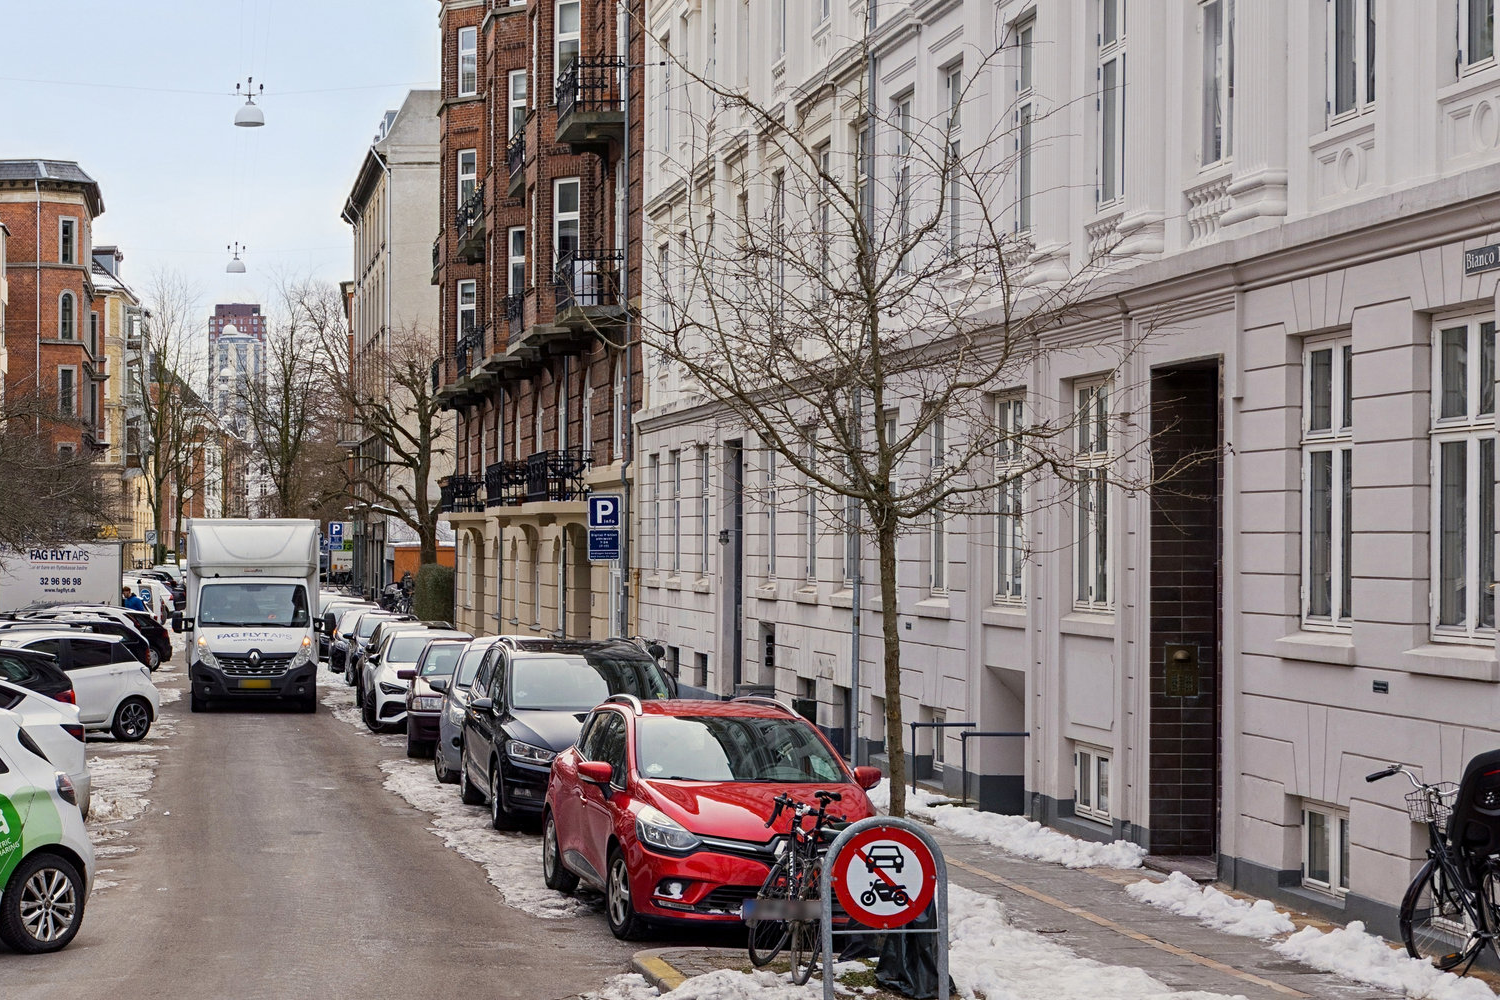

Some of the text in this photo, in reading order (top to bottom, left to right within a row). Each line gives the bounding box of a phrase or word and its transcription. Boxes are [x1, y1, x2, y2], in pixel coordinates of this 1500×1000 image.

[1466, 252, 1495, 270] Bianco
[596, 501, 614, 524] P
[332, 524, 340, 535] P
[30, 550, 90, 561] FAG FLYT APS
[40, 577, 82, 586] 32 96 96 98
[217, 632, 240, 640] FAG
